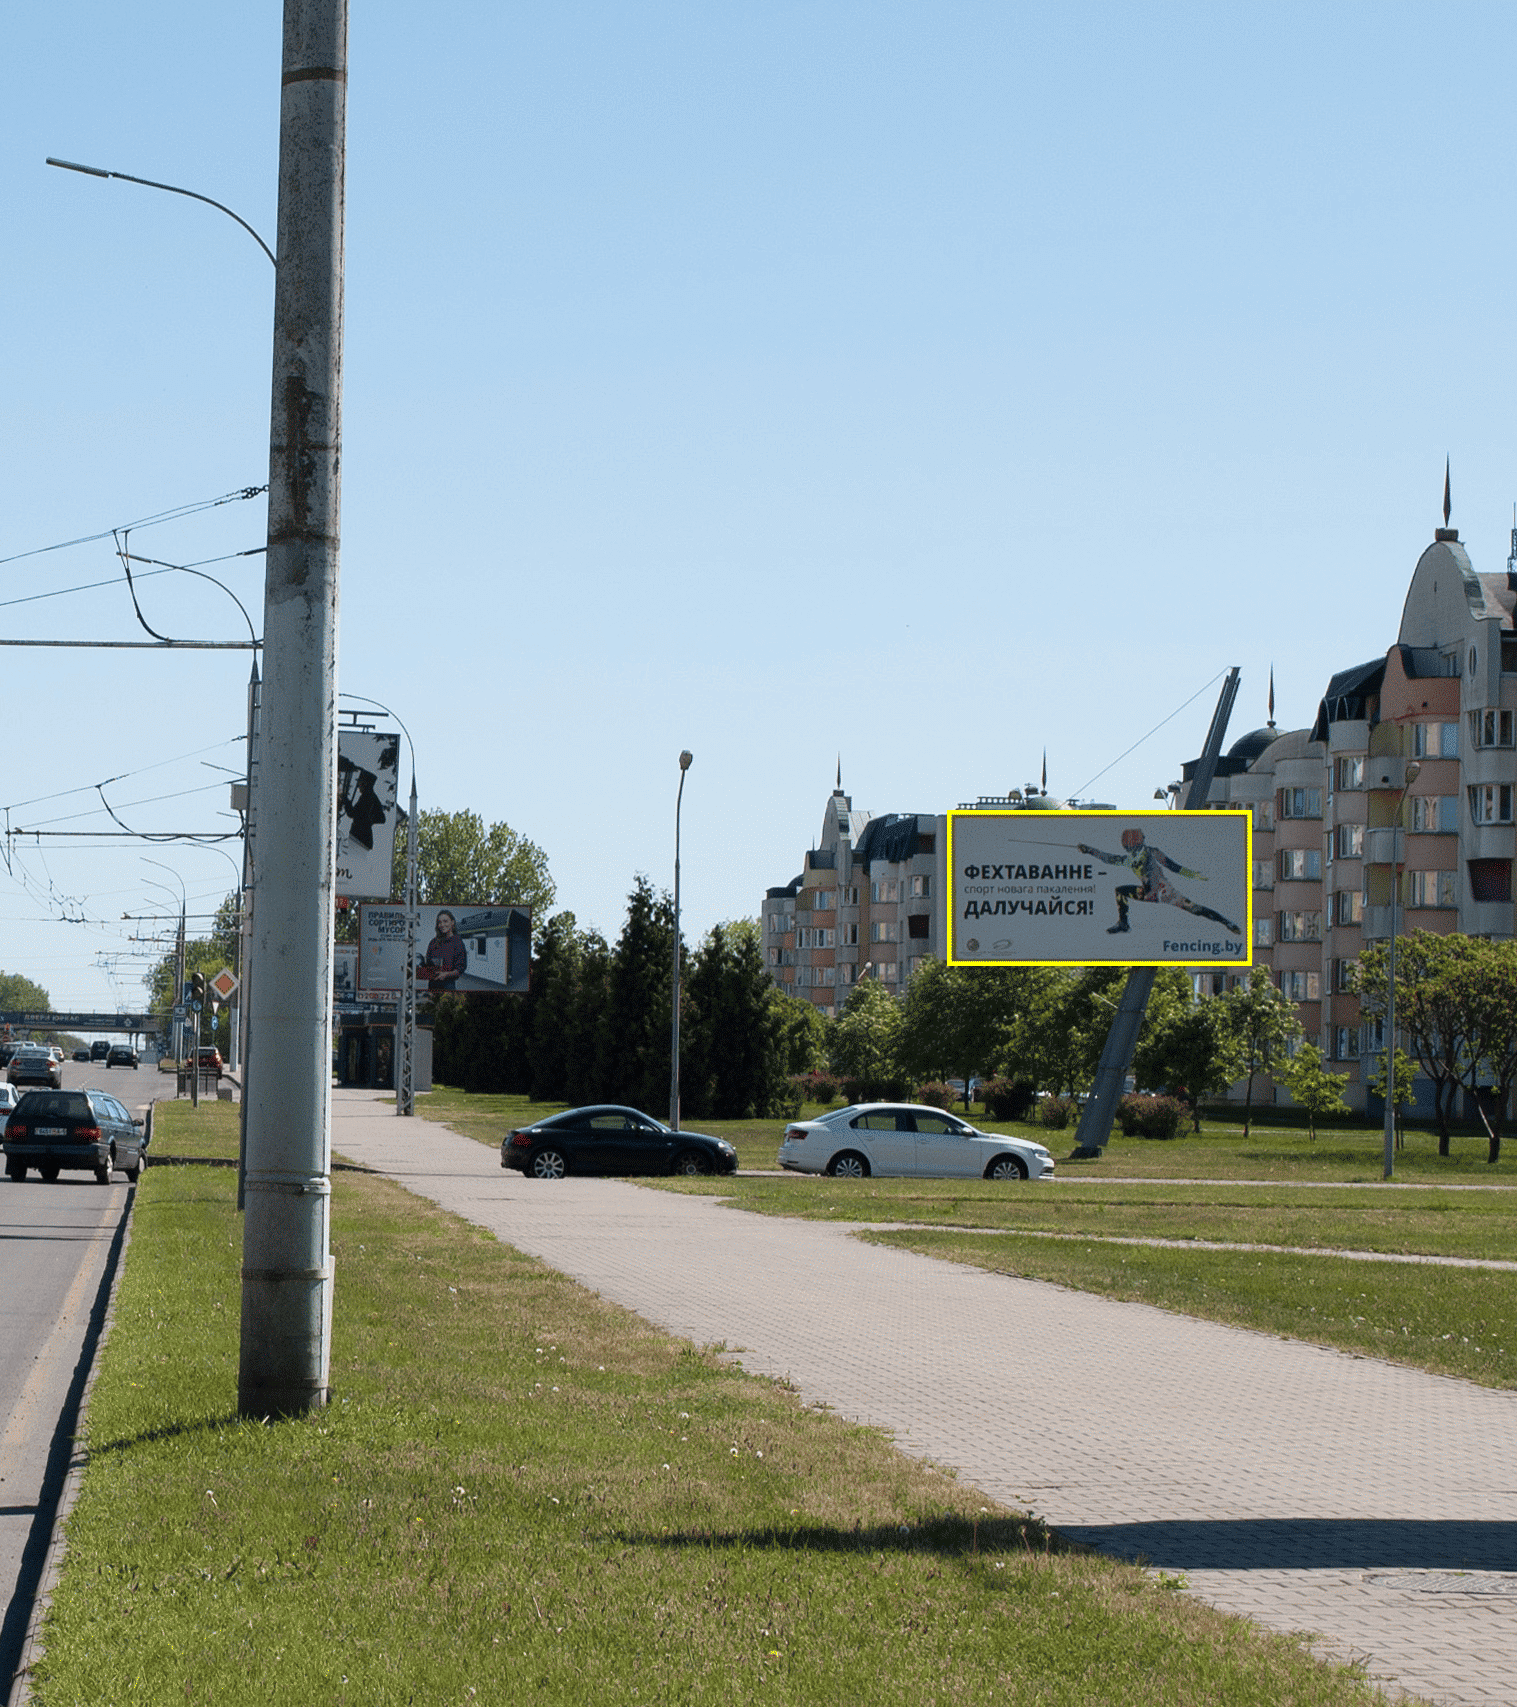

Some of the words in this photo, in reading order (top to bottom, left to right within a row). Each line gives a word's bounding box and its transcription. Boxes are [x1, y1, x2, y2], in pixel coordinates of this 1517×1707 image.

[964, 864, 1093, 880] ФЕХТАВАННЕ
[964, 885, 994, 896] спорт
[997, 885, 1033, 894] новага
[1036, 884, 1096, 894] пакалення!
[964, 895, 1094, 920] ДАЛУЧАЙСЯ!
[1162, 939, 1243, 955] Fencing.by
